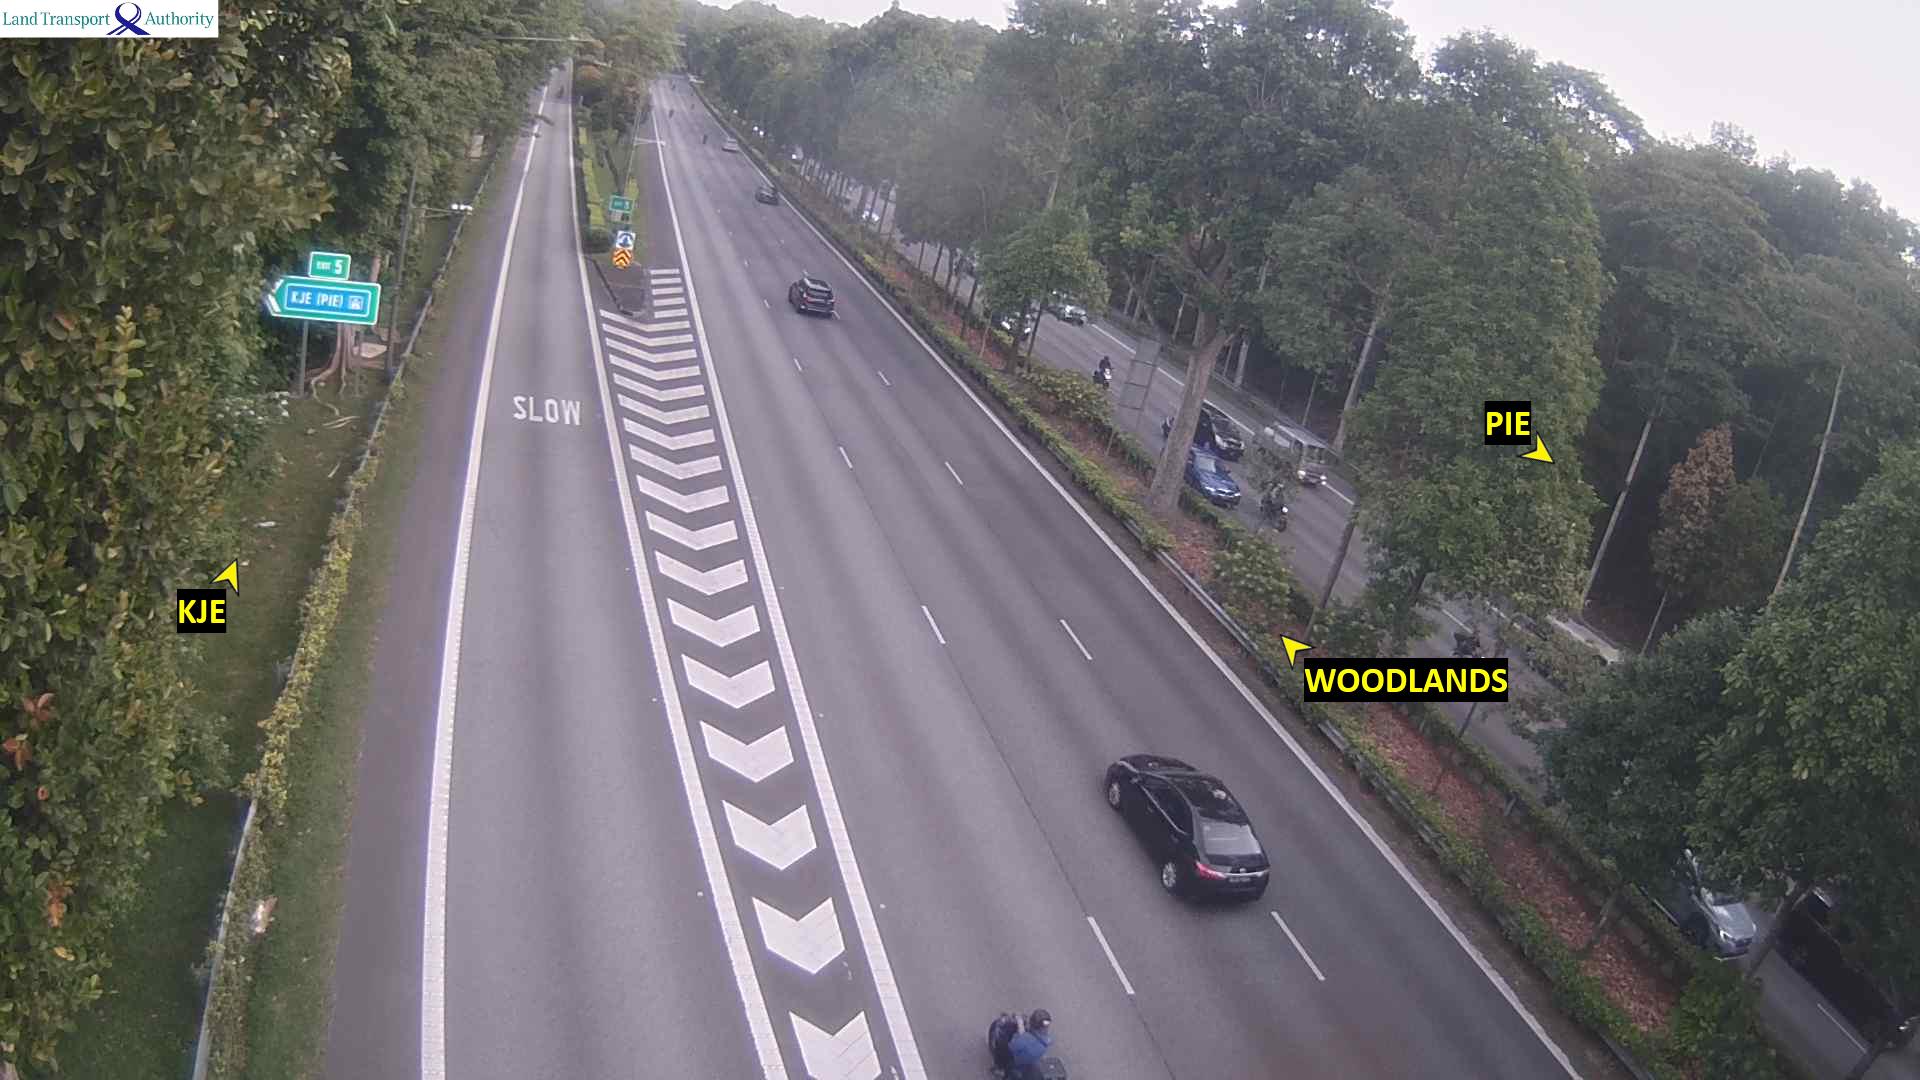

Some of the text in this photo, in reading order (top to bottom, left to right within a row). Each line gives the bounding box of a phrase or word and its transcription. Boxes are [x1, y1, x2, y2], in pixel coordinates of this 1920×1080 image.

[334, 259, 343, 275] 5
[291, 291, 312, 305] KJE
[513, 396, 580, 425] SLOW
